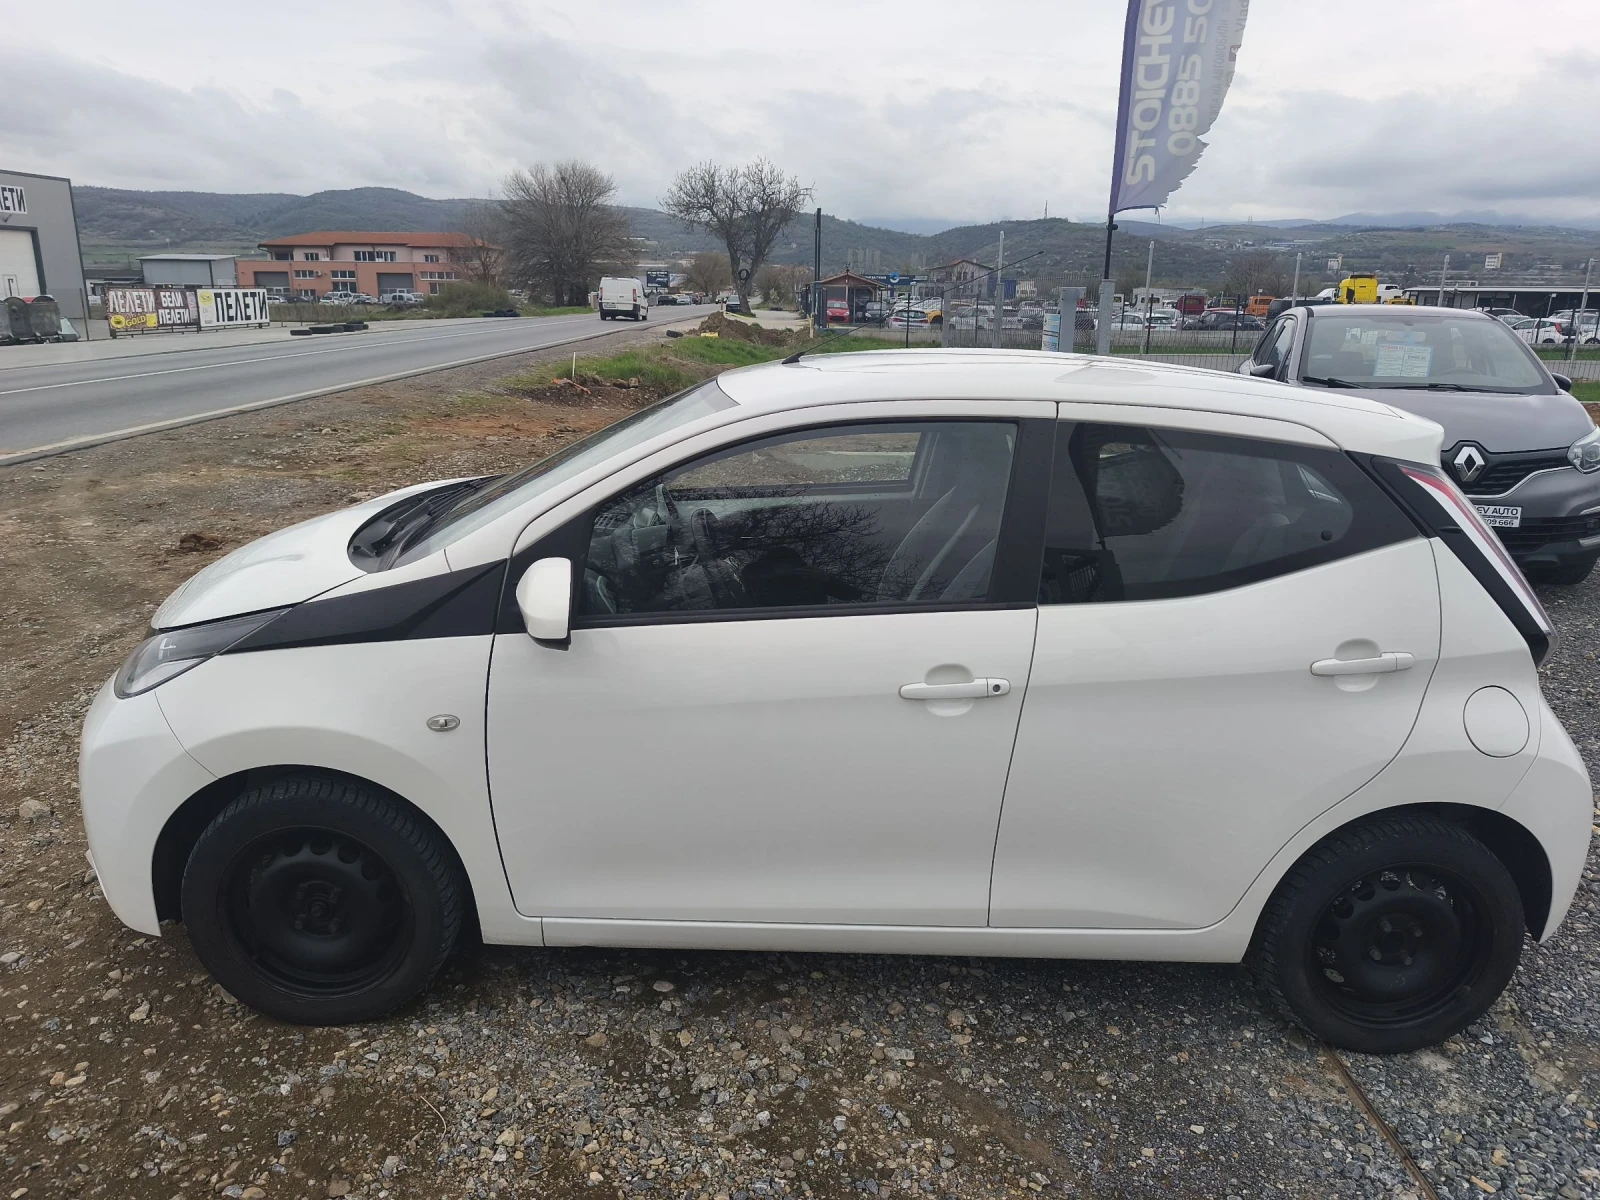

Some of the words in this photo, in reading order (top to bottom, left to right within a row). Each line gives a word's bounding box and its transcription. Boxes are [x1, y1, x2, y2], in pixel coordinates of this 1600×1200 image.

[1211, 19, 1229, 81] АВТОМОБИЛИ
[1167, 54, 1202, 157] 0885
[108, 290, 156, 313] ПЕЛЕТИ
[160, 291, 184, 307] БЕЛИ
[213, 291, 268, 323] ПЕЛЕТИ
[125, 315, 146, 327] GOLD
[158, 308, 190, 325] ПЕЛЕТИ
[1492, 508, 1518, 516] AUTO
